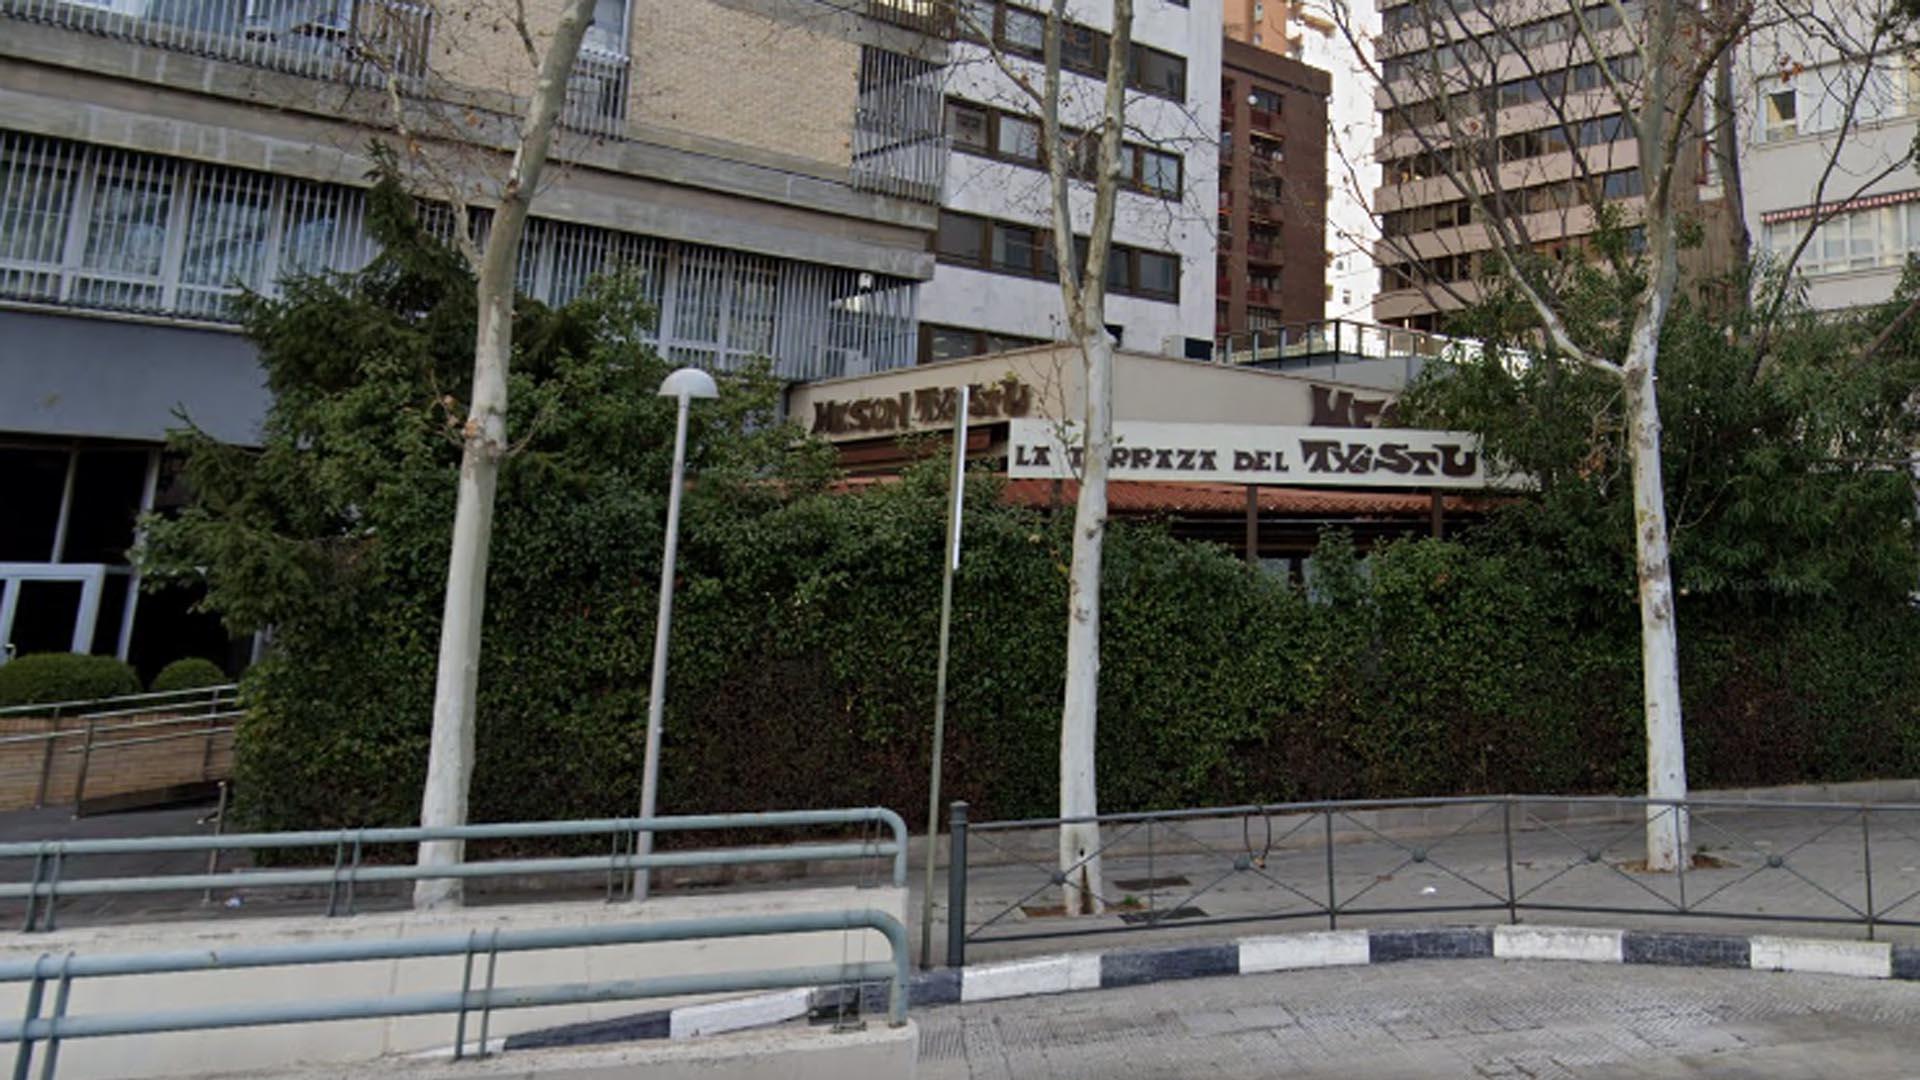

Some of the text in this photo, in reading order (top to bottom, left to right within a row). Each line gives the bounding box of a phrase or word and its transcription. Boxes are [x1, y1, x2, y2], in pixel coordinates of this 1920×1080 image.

[1015, 446, 1050, 466] LA
[1069, 447, 1217, 471] TRRAZA
[1233, 450, 1289, 472] DEL
